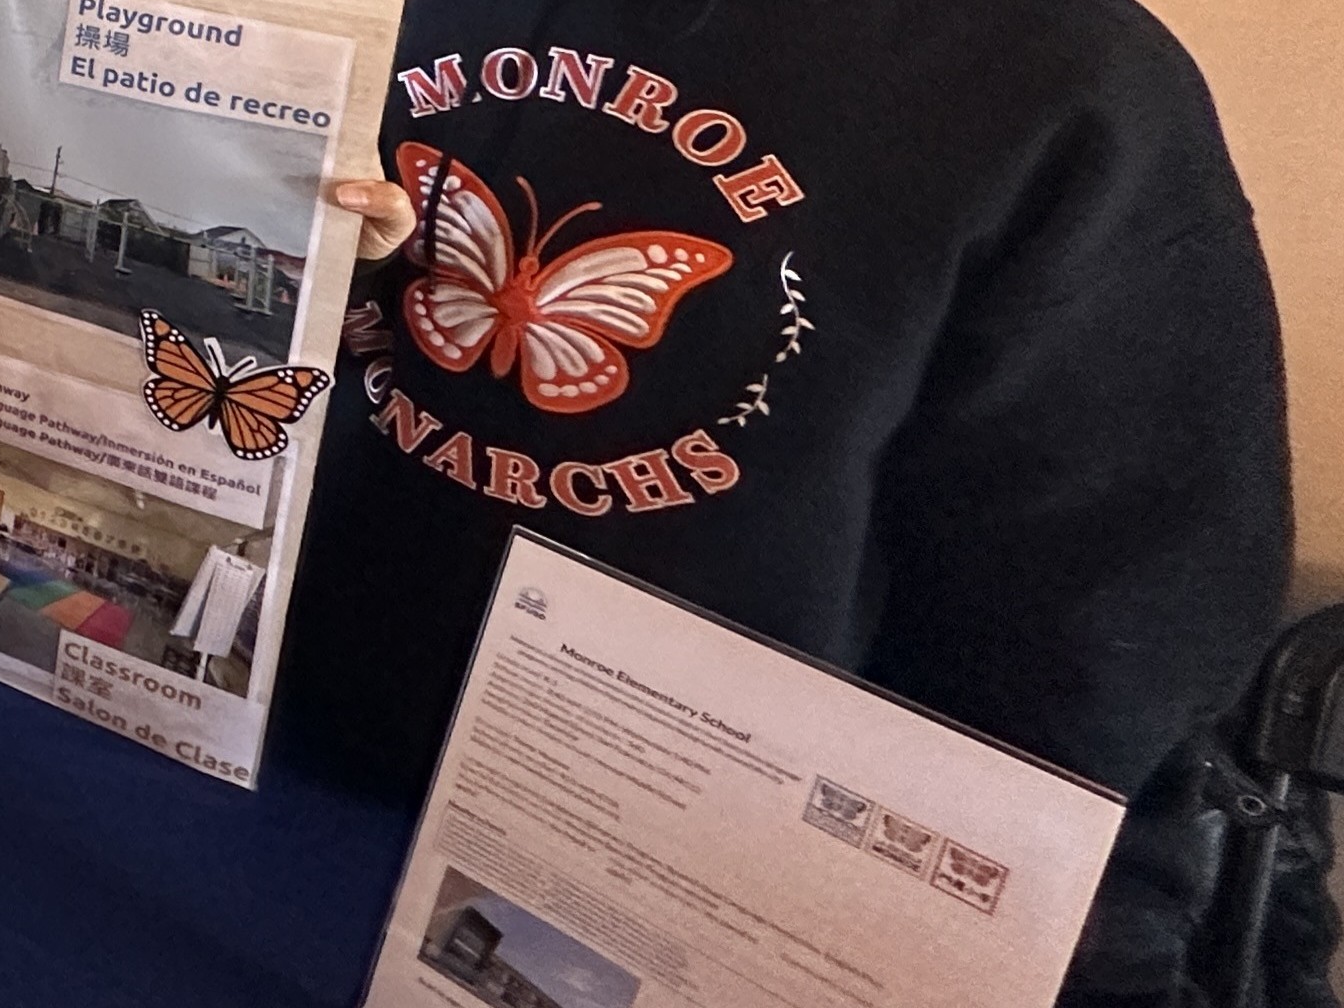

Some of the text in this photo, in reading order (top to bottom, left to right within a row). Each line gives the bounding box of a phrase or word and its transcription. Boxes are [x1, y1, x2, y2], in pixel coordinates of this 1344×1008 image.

[75, 23, 130, 57] 操場
[70, 55, 331, 128] El patio de recreo
[398, 46, 806, 223] MONROE
[343, 300, 741, 516] MONARCHS
[39, 413, 174, 469] Pathway/Inmersión
[178, 463, 196, 476] en
[200, 469, 261, 496] Español
[64, 642, 202, 710] Classroom
[560, 644, 752, 744] Monroe Elementary School
[58, 687, 250, 781] Salon de Clase
